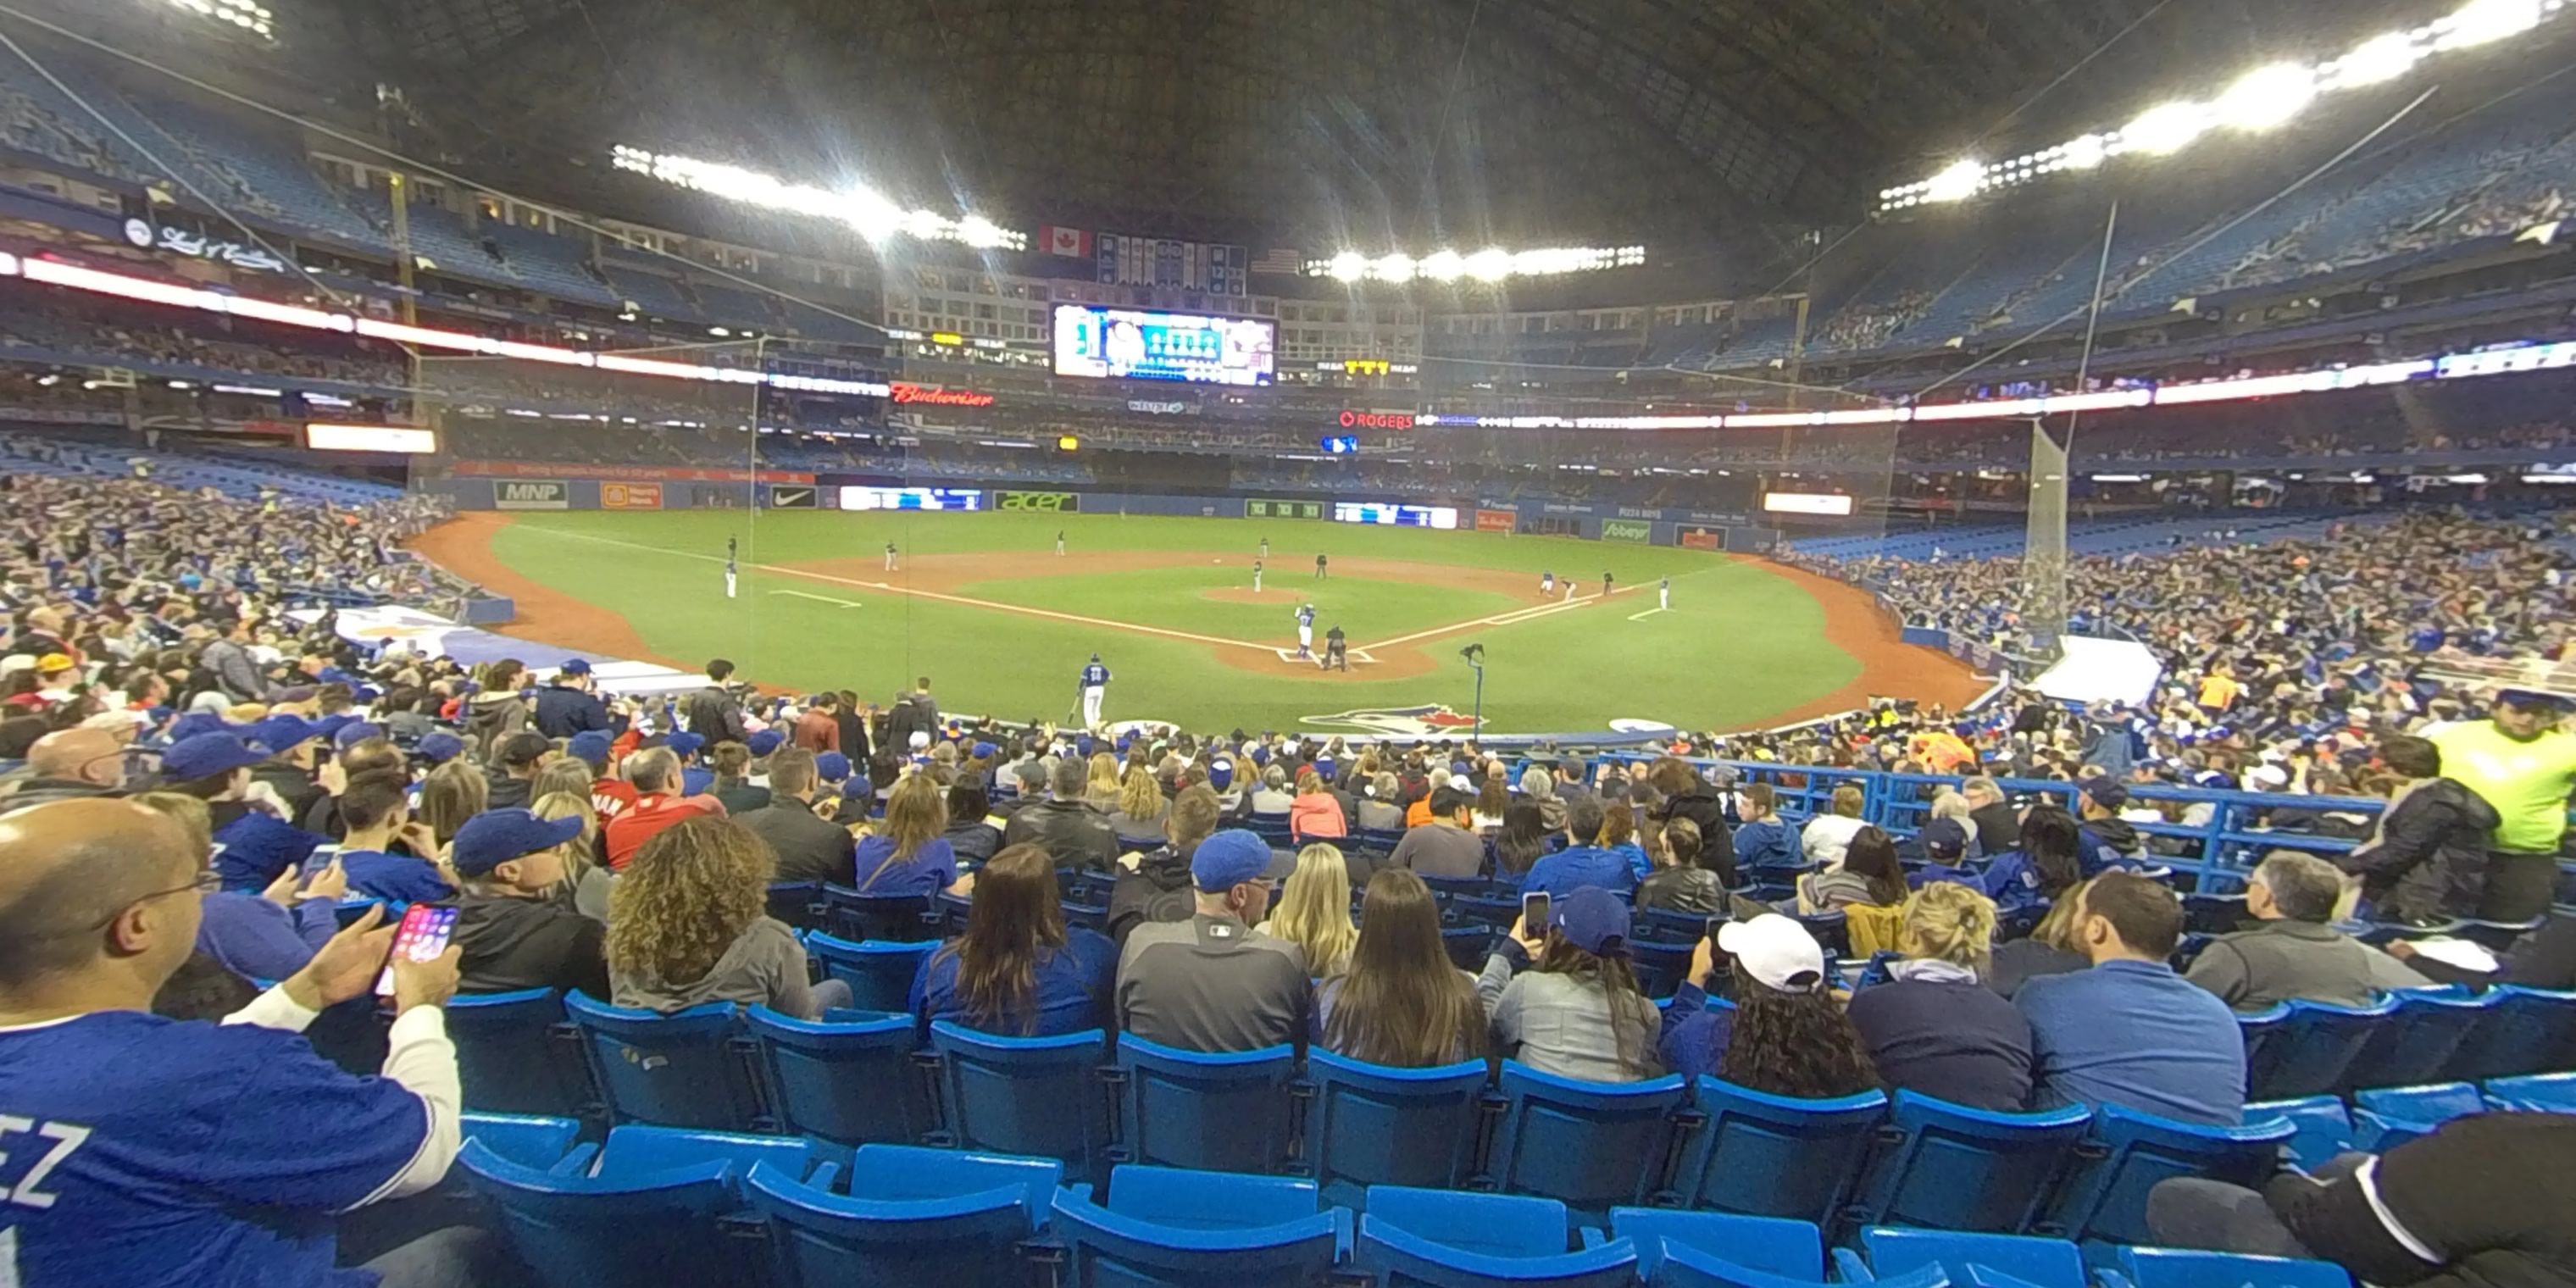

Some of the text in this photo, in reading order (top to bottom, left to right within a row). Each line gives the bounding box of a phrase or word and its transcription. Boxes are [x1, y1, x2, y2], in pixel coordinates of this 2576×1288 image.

[890, 384, 994, 407] Budweiser
[1357, 414, 1413, 430] ROGERS
[506, 484, 558, 500] MNP
[1002, 492, 1072, 512] acer
[1604, 523, 1648, 540] Sobeys
